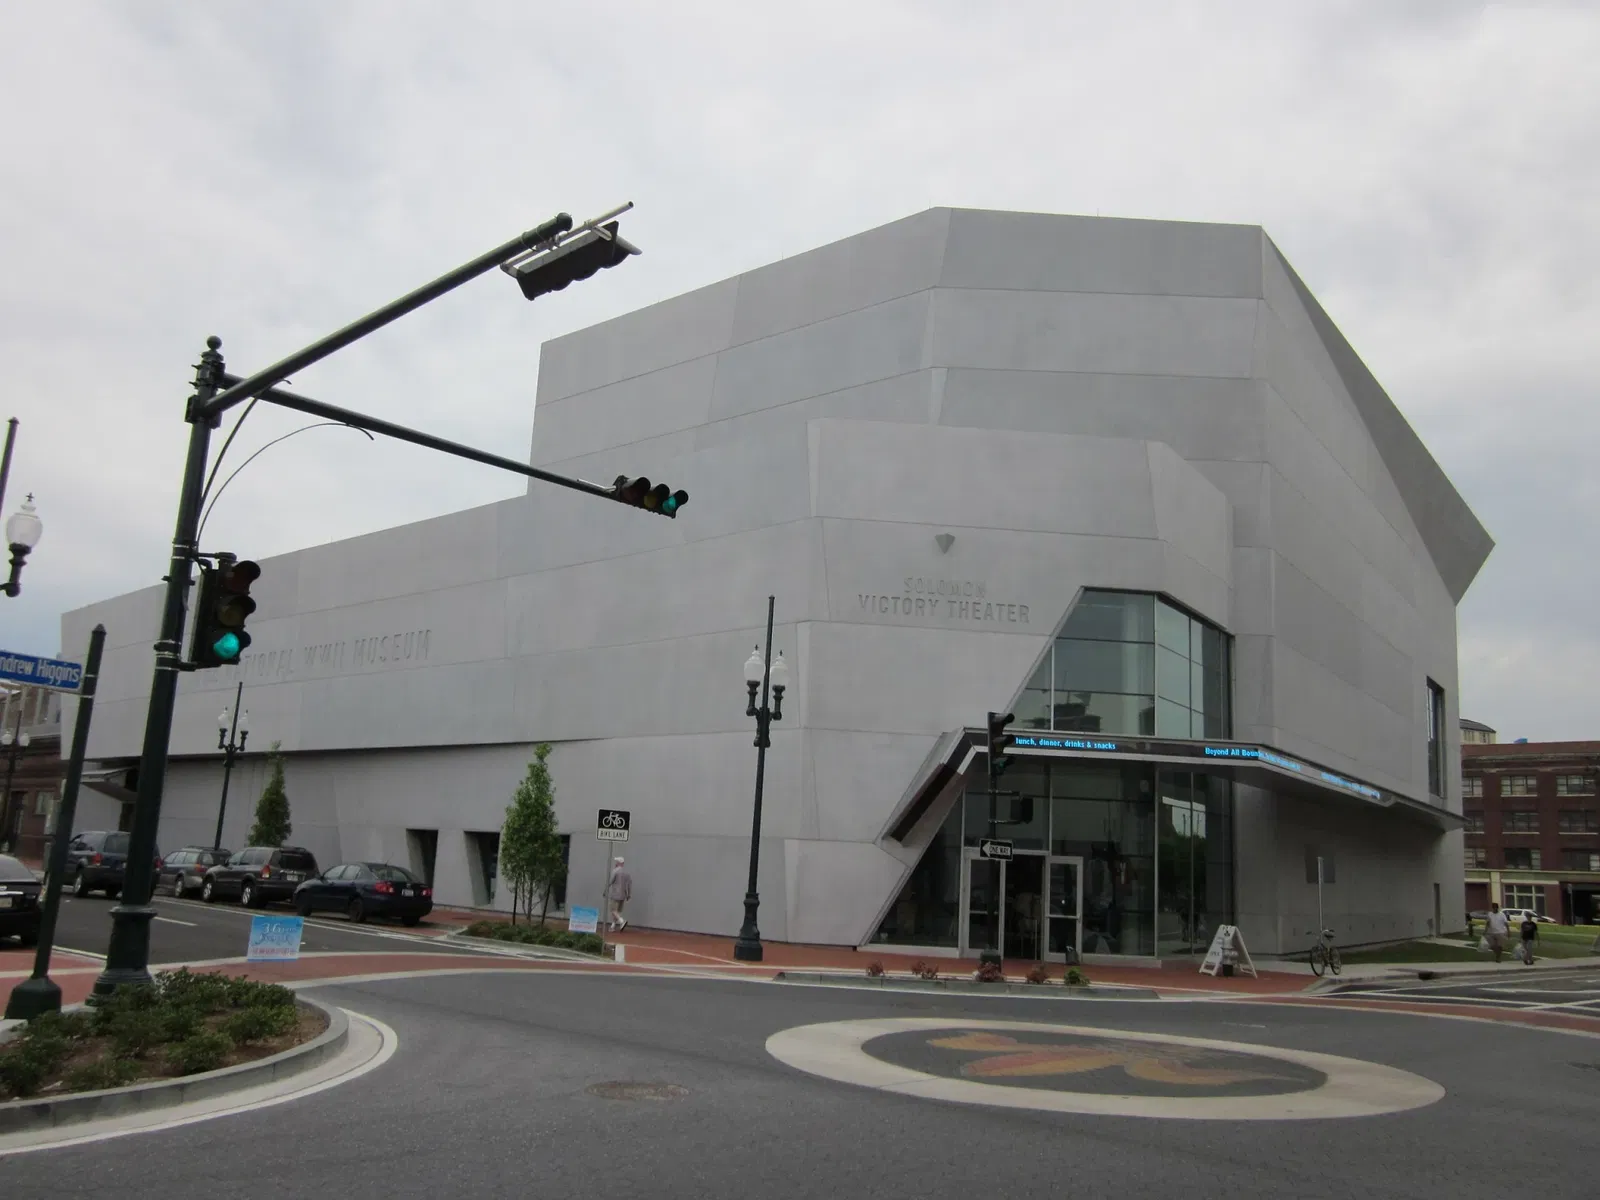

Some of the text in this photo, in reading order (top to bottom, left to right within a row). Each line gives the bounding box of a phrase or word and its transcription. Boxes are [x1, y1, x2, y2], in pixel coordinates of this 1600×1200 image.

[903, 576, 988, 600] SOLOMON
[858, 594, 1030, 624] VICTORY THEATER
[353, 628, 431, 667] MUSEUM
[0, 655, 80, 685] ndrew Higgins
[1015, 737, 1116, 750] lunch, dinner, drinks & snacks
[1205, 746, 1229, 757] Beyond
[1230, 748, 1240, 756] All
[600, 830, 626, 839] BIKE LANE
